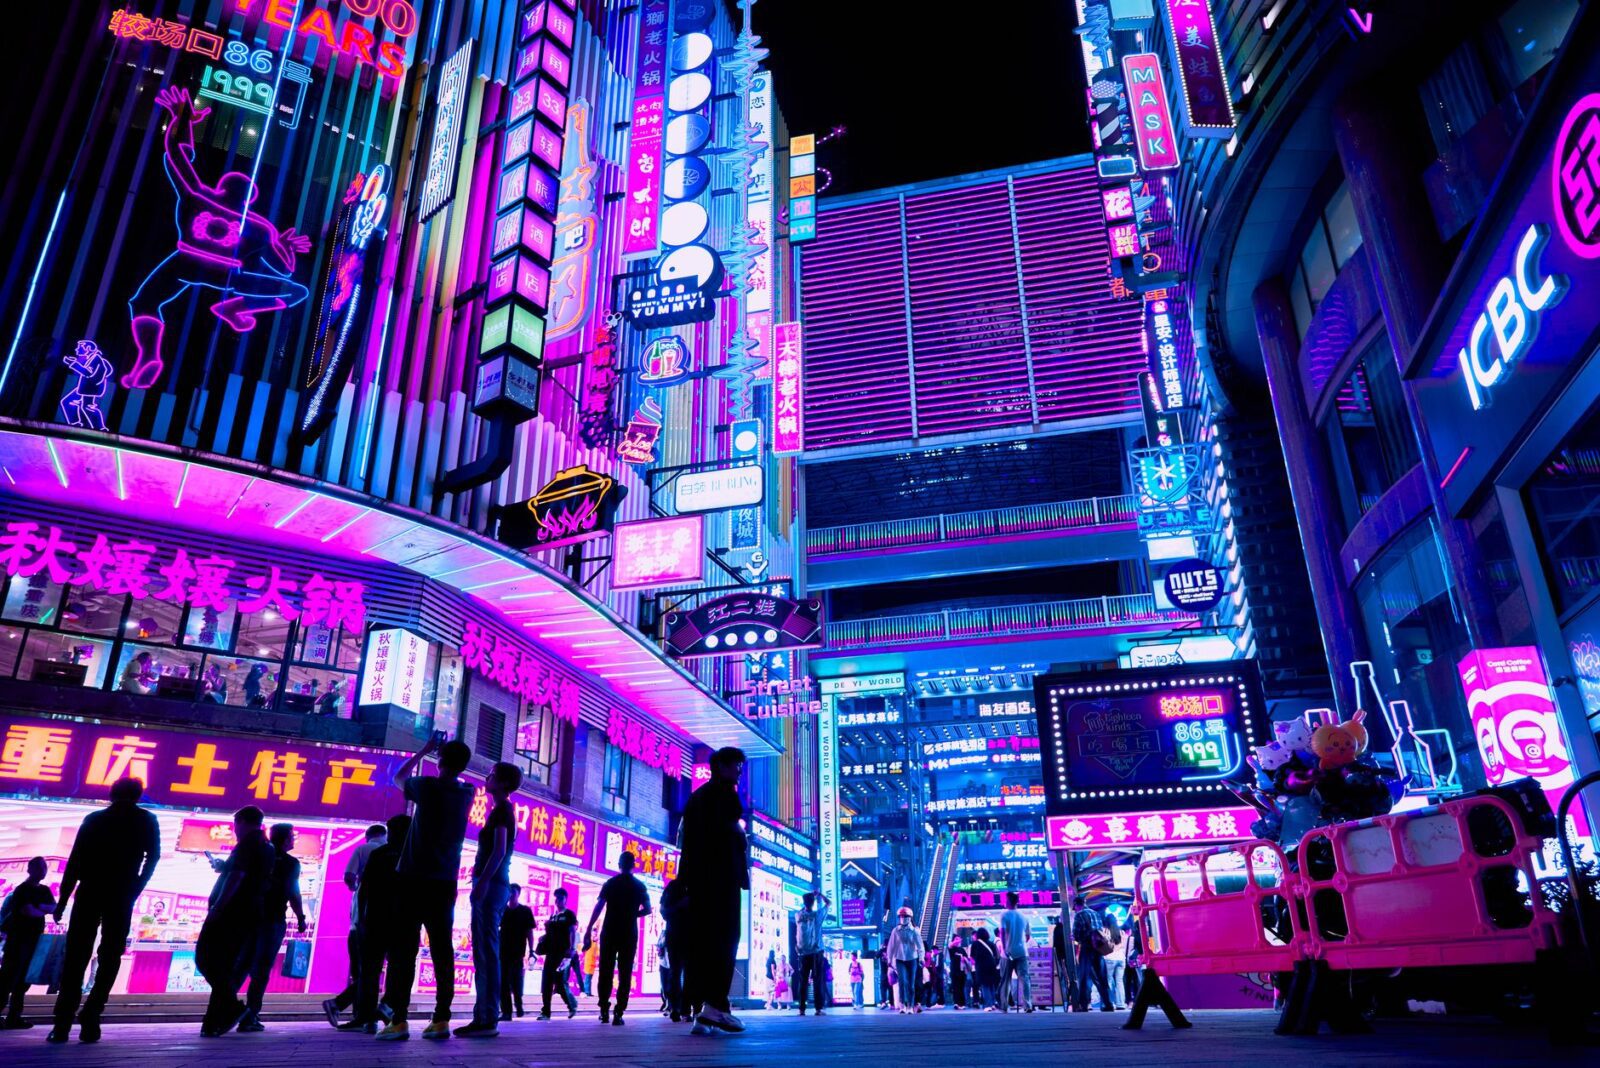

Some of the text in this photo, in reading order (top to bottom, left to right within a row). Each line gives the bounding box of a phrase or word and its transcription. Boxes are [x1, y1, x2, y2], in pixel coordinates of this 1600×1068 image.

[108, 9, 224, 61] 较场口
[1131, 68, 1166, 156] MASK
[790, 221, 816, 236] KTV
[632, 298, 705, 319] YUMMY!
[1459, 223, 1562, 411] ICBC
[744, 675, 813, 698] Street
[852, 680, 862, 688] YI
[869, 676, 902, 687] WORLD
[744, 698, 823, 720] Cuisine
[822, 702, 828, 713] DE
[1160, 695, 1223, 718] 较场口
[0, 724, 378, 806] 重庆土特产
[824, 775, 830, 786] DE
